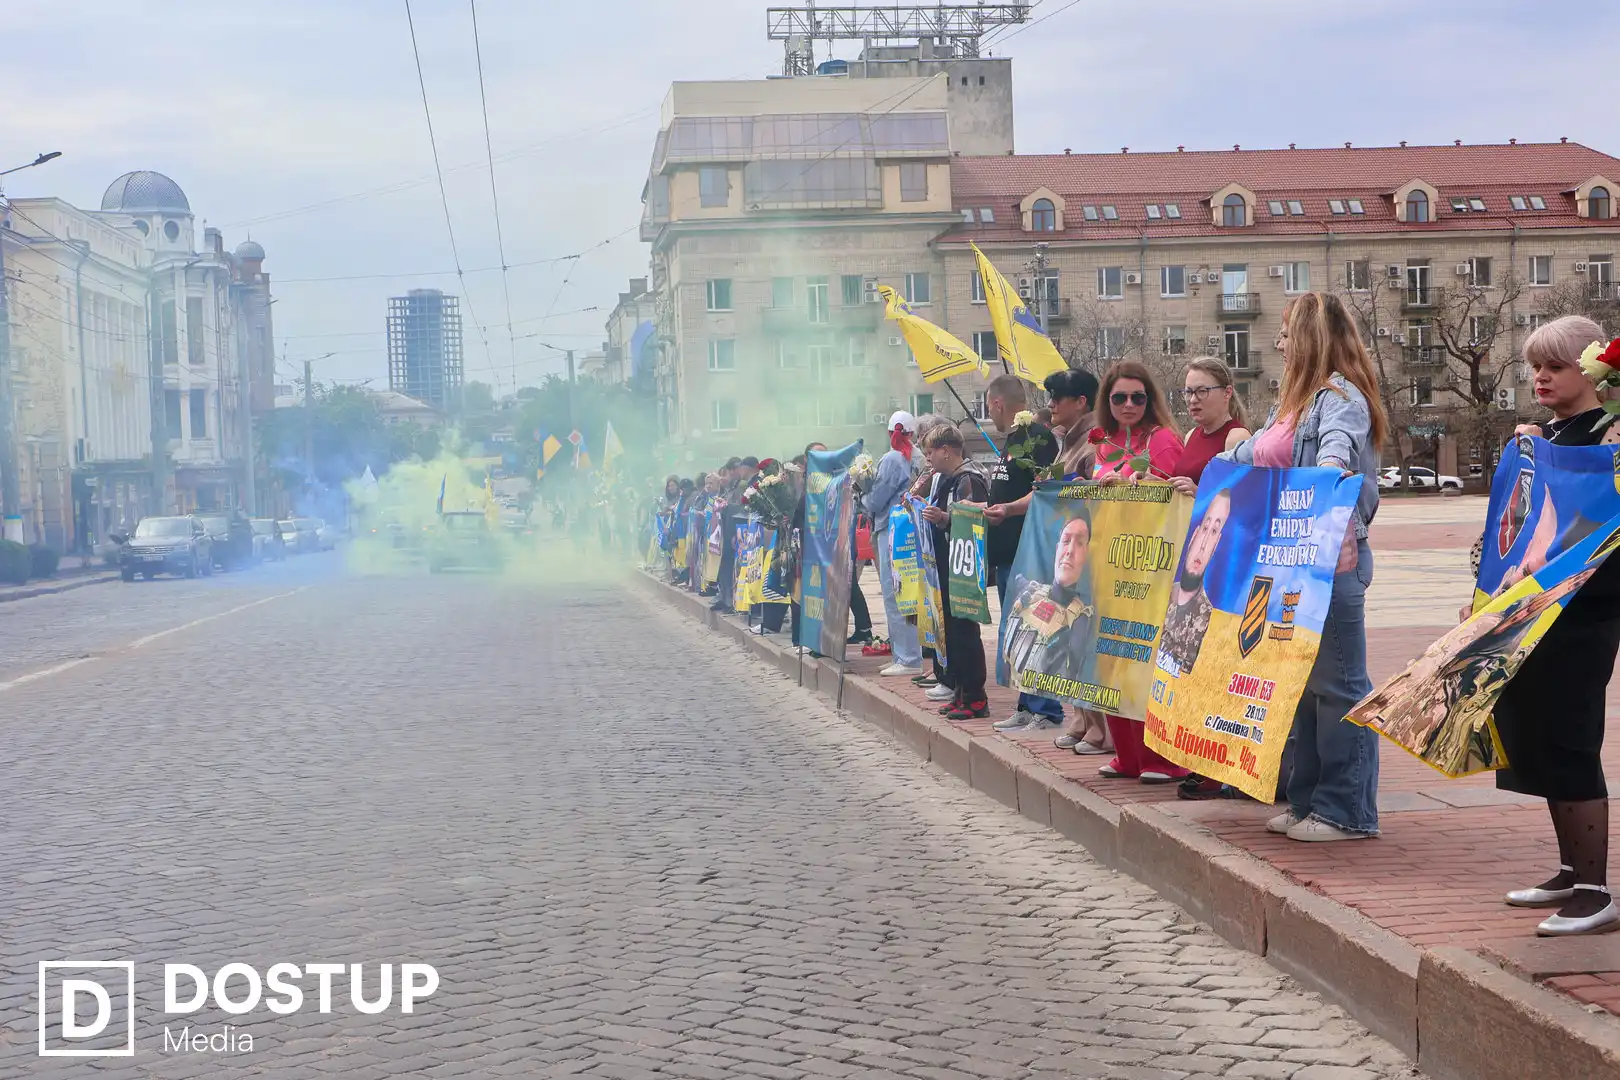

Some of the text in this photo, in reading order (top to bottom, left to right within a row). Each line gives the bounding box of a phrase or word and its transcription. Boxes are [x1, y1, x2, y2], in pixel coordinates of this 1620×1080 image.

[1021, 669, 1036, 688] МИ
[1036, 673, 1082, 699] ЗНАЙДЕМО
[1227, 672, 1260, 698] ЗНИК
[1211, 716, 1250, 738] Греківка
[1174, 724, 1236, 768] Віримо...
